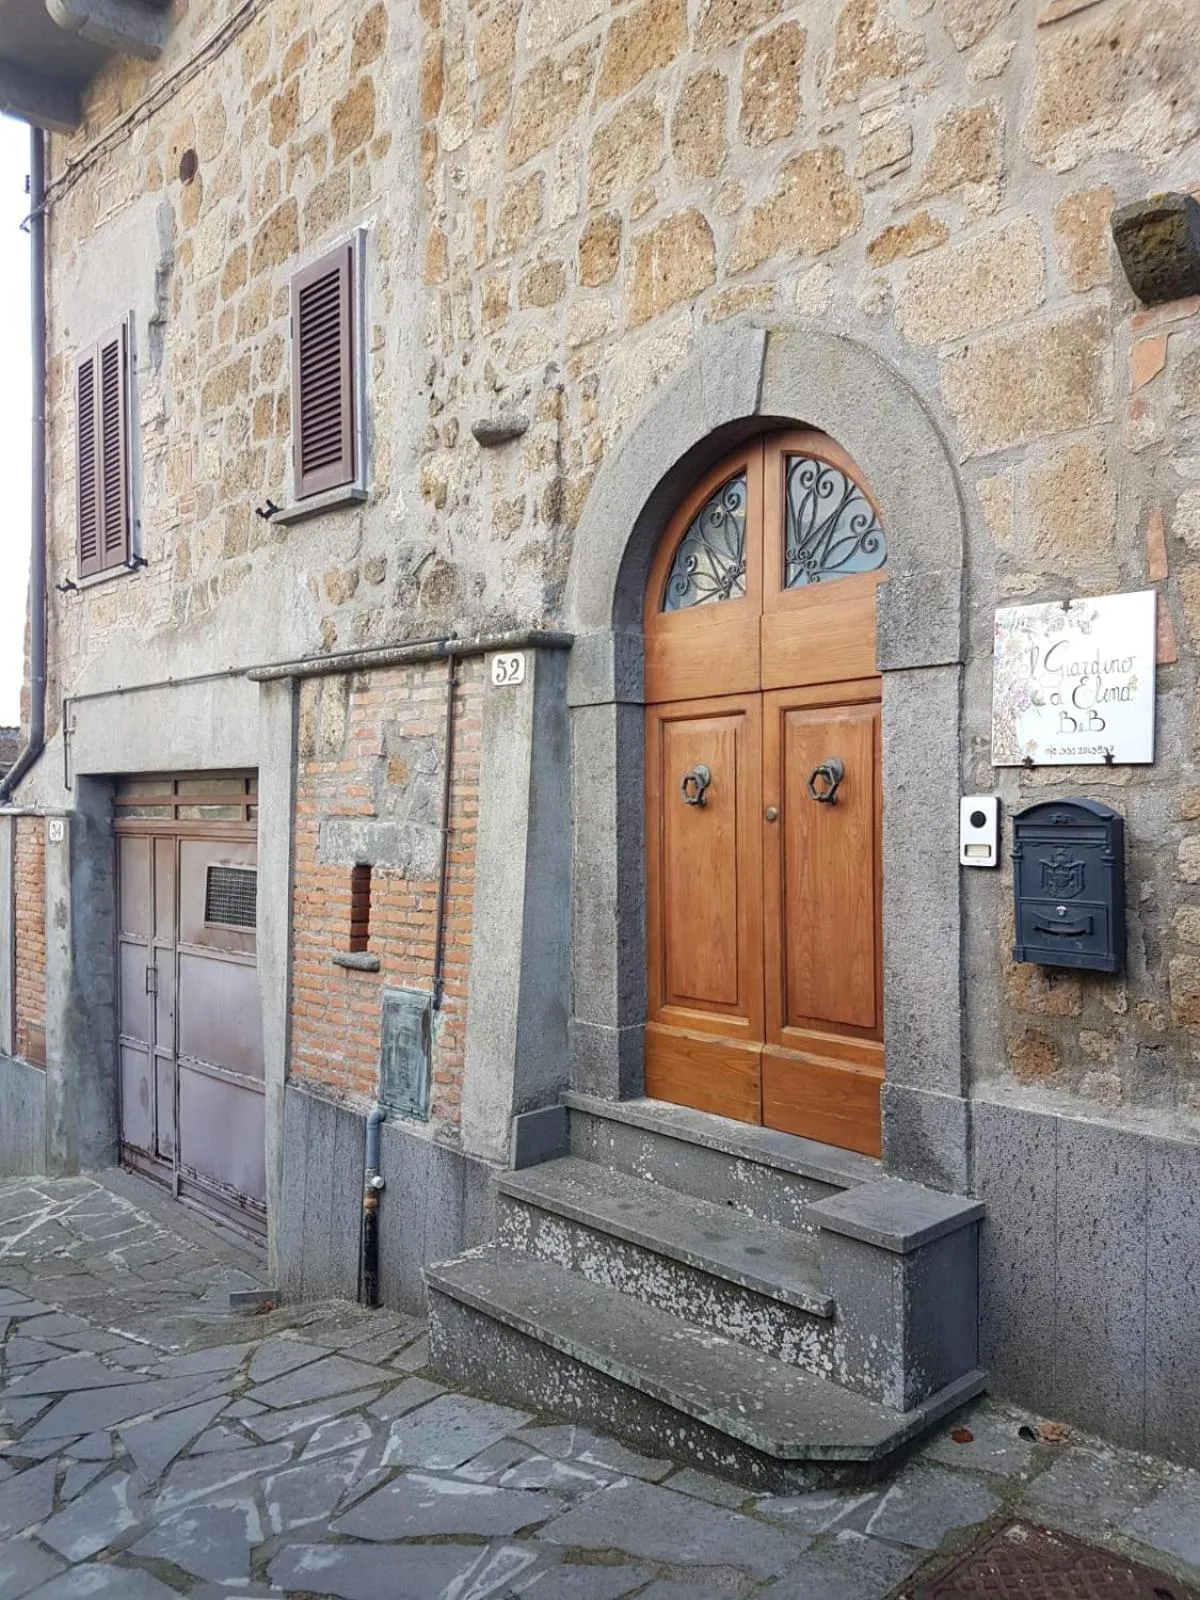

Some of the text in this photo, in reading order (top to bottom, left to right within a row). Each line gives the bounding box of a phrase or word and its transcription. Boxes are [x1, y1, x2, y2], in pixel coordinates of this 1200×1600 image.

[495, 658, 520, 682] 52
[1040, 640, 1137, 685] Giardino
[1071, 675, 1133, 709] Elena
[51, 823, 62, 837] 54
